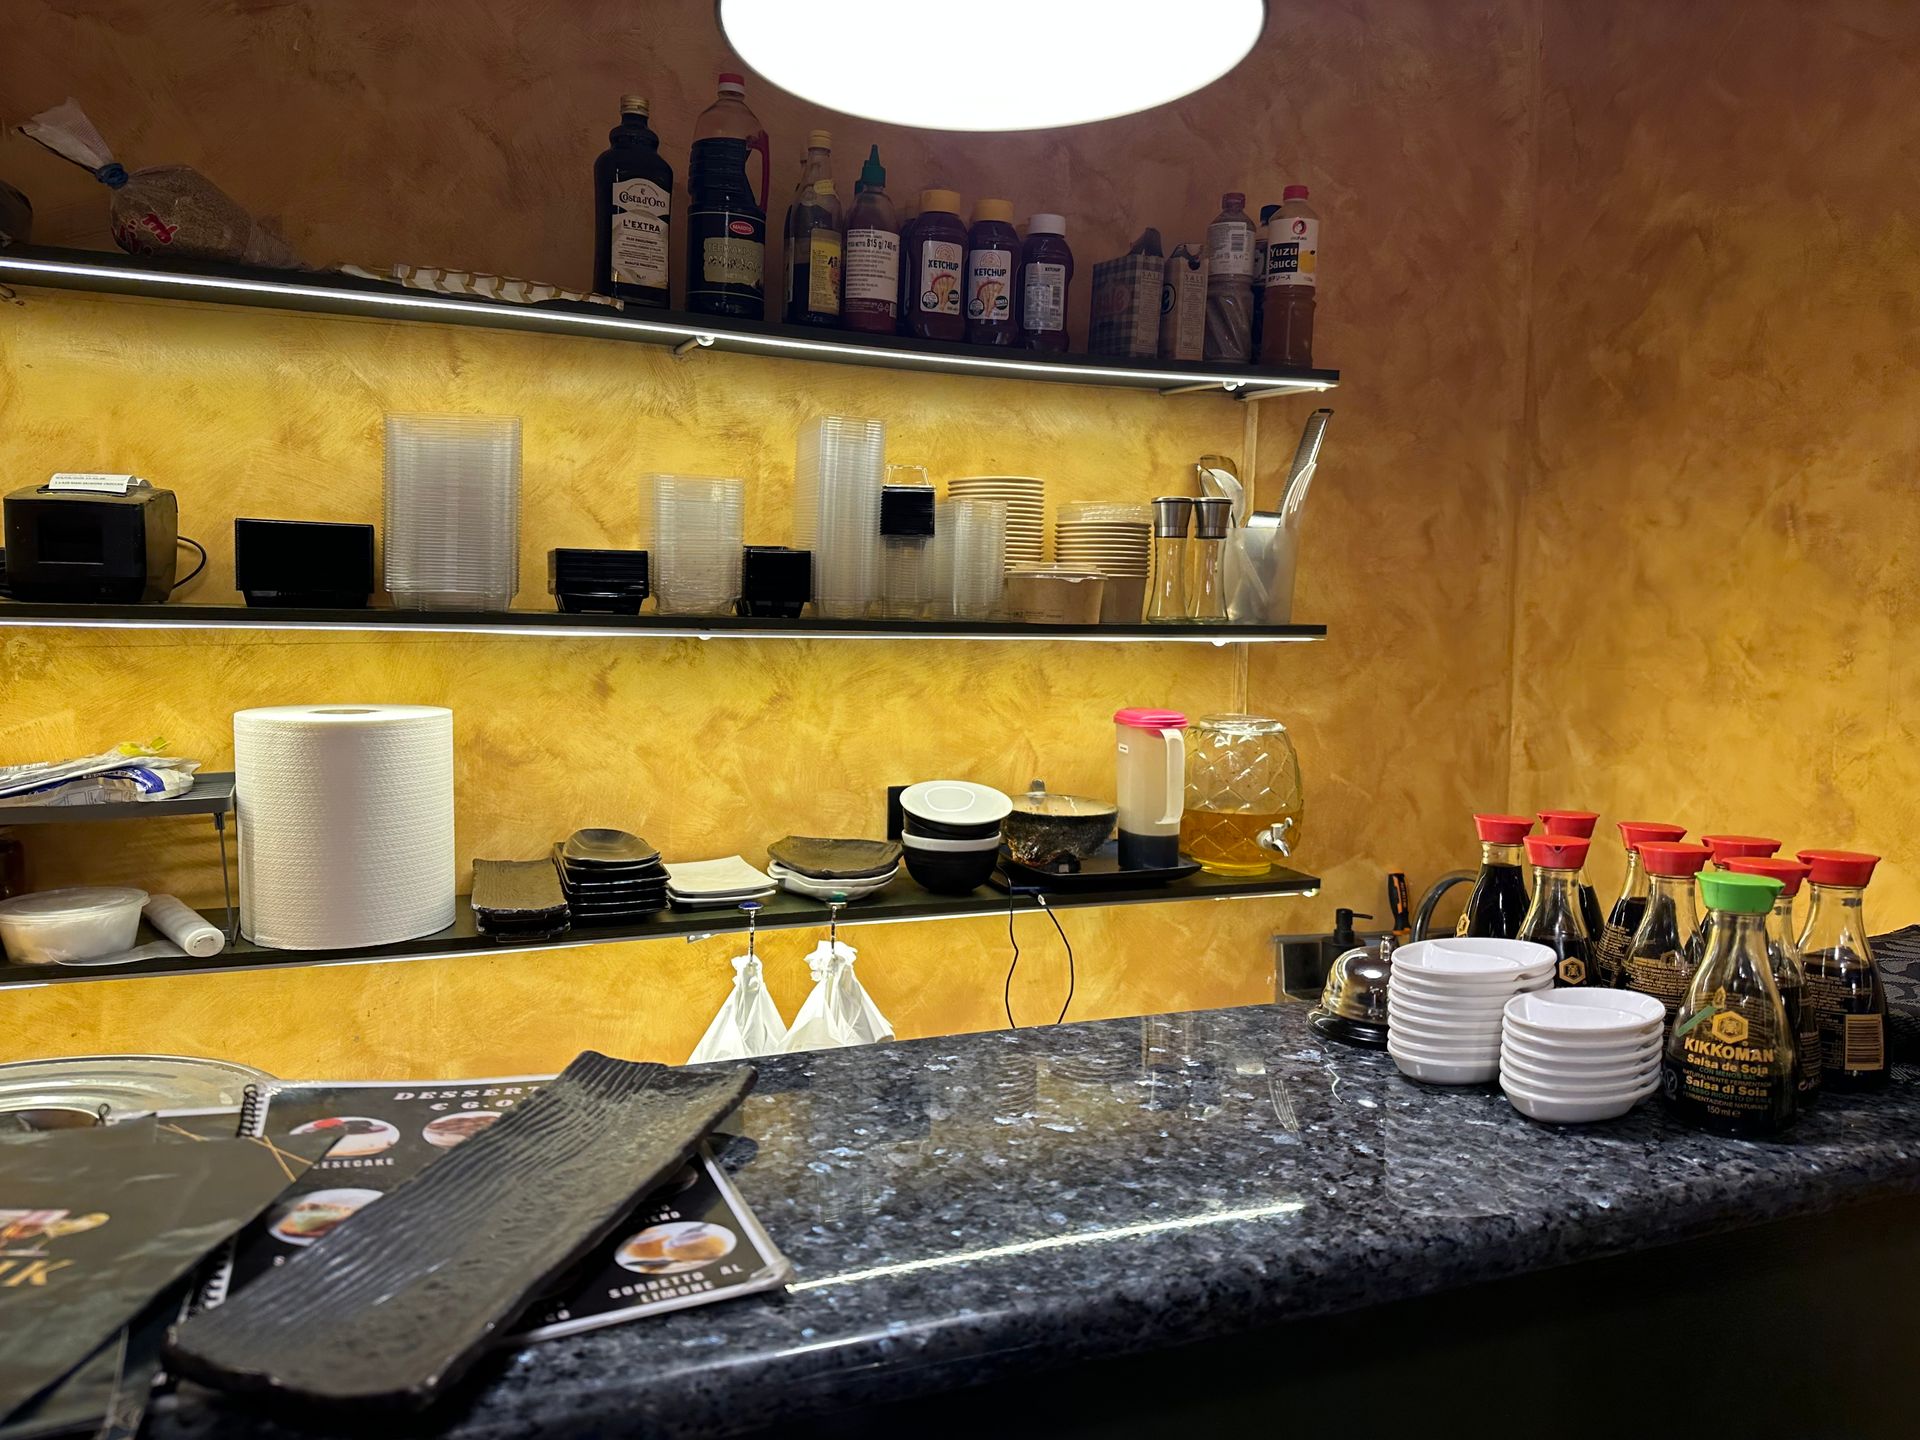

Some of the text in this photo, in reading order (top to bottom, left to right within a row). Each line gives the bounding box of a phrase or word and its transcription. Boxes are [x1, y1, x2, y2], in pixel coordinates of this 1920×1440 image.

[623, 219, 661, 232] L'EXTRA
[867, 238, 877, 248] 815
[1270, 246, 1298, 257] Yuzu
[928, 259, 959, 271] KETCHUP
[1269, 259, 1297, 270] Sauce
[974, 268, 1007, 277] KETCHUP
[1683, 1037, 1775, 1063] KIKKOMAN
[1686, 1053, 1769, 1077] Salsa de Soja
[1698, 1066, 1715, 1075] CON
[1682, 1067, 1729, 1084] NATURALMENTE
[1685, 1075, 1768, 1097] Salsa di Soia
[1687, 1085, 1710, 1096] TASSO
[1710, 1091, 1745, 1102] RIDOTTO
[1707, 1104, 1720, 1115] 150
[1720, 1106, 1731, 1117] ml
[1734, 1100, 1768, 1110] NATURALE
[607, 1263, 744, 1299] SORBETTO AL
[640, 1280, 715, 1304] LIMONE
